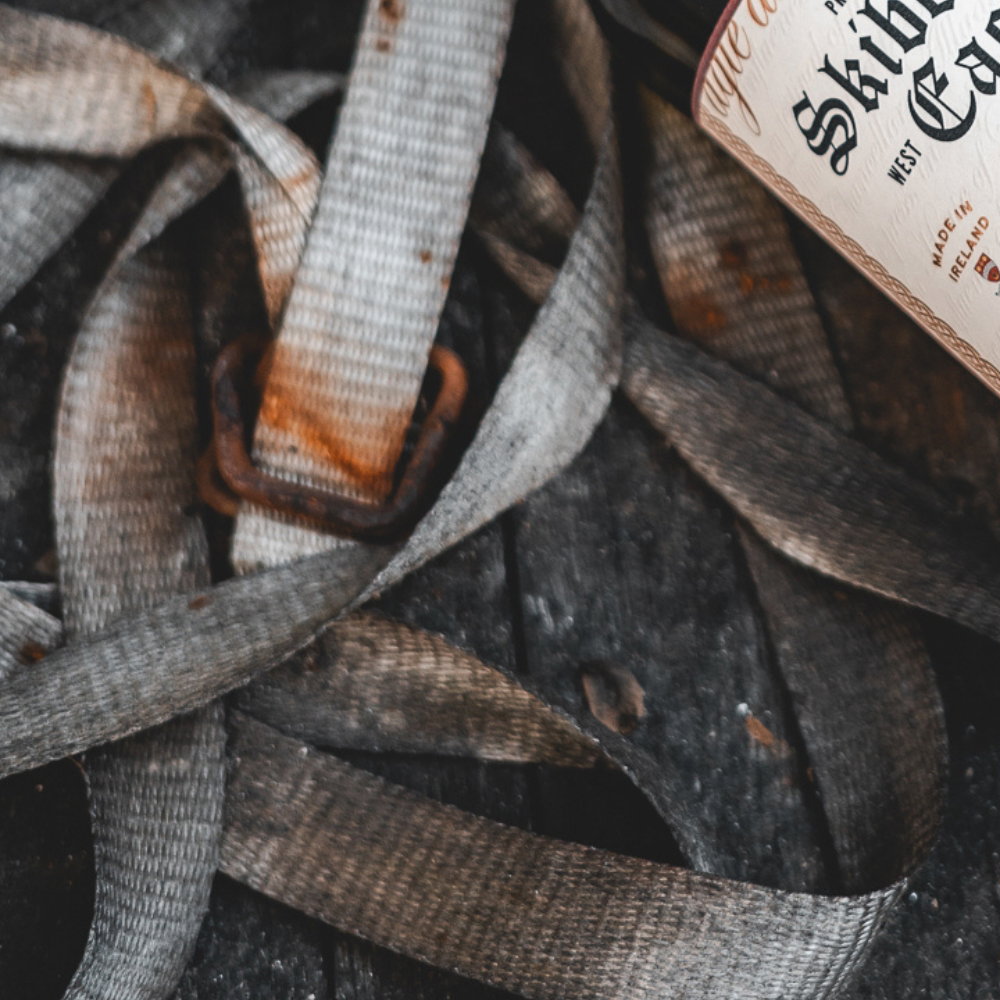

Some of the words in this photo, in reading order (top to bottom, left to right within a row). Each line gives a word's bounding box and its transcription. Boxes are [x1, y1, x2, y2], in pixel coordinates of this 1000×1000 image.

[888, 140, 921, 185] WEST
[933, 219, 956, 267] MADE
[954, 201, 972, 219] IN
[949, 217, 988, 282] IRELAND
